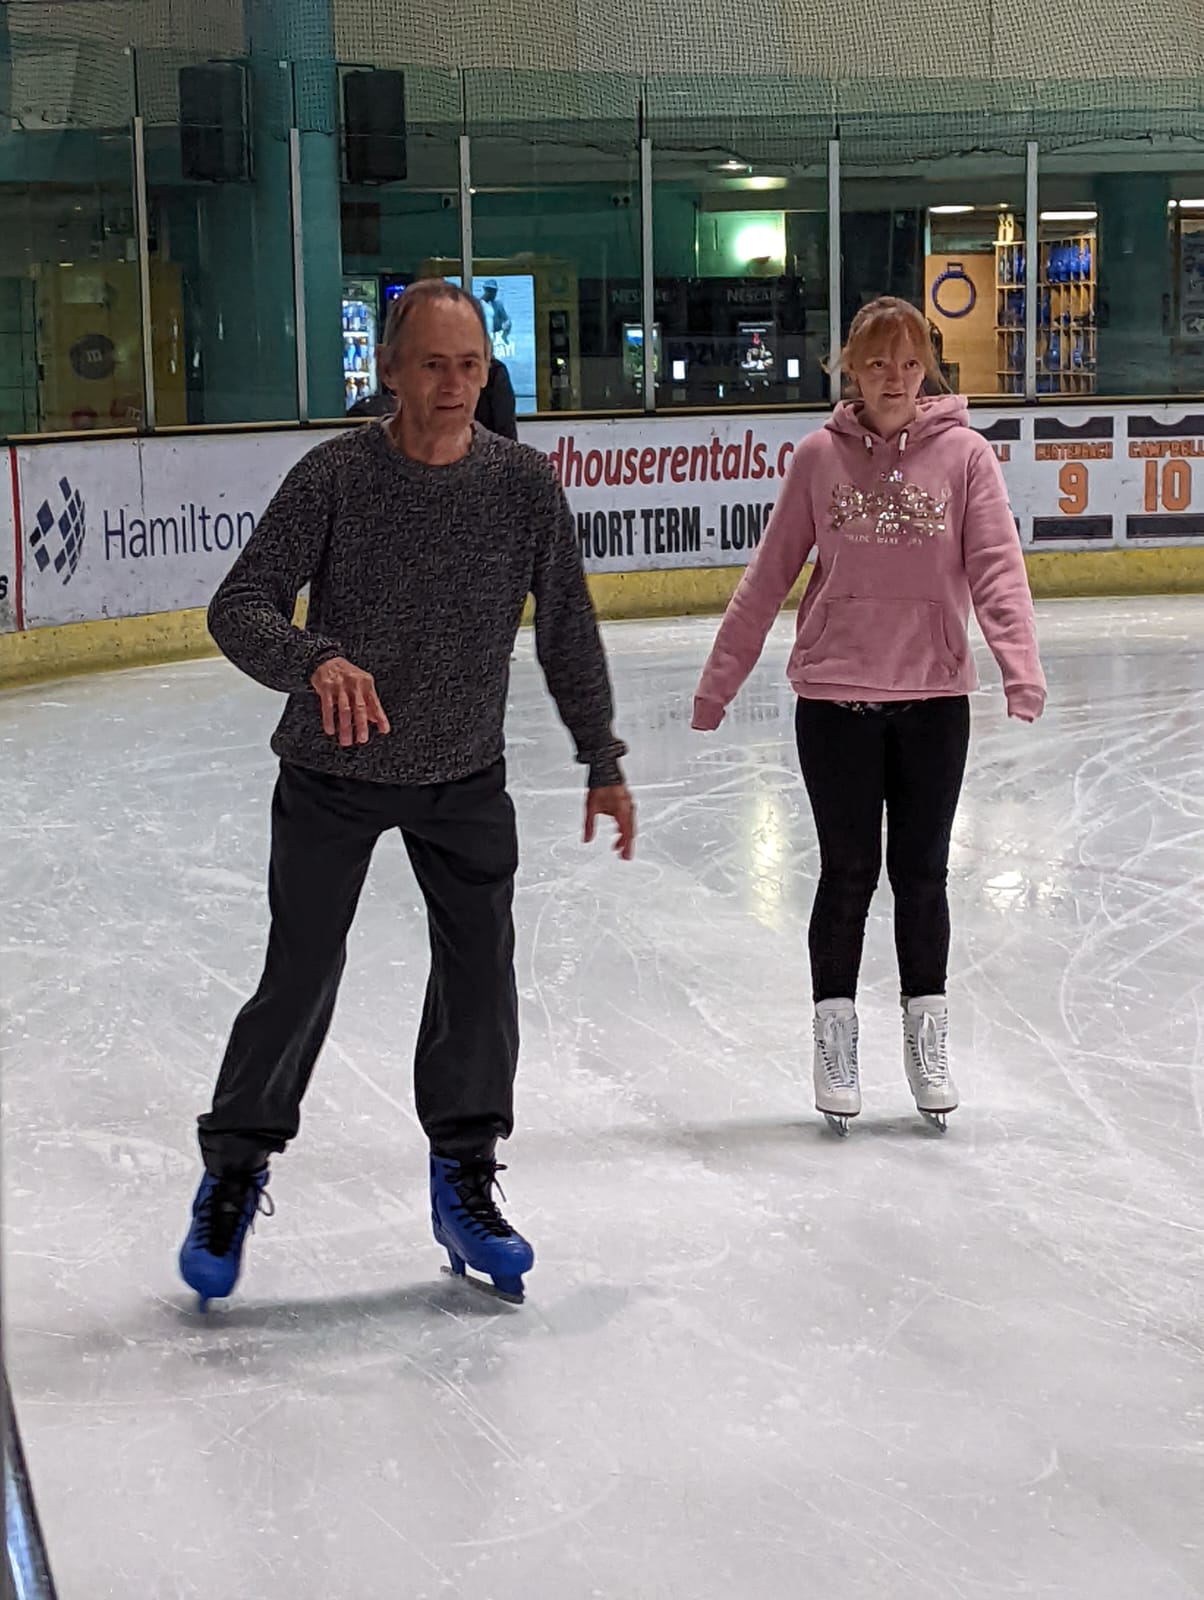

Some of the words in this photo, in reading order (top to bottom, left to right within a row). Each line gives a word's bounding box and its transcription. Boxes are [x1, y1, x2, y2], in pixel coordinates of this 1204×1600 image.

[1058, 462, 1089, 514] 9
[1144, 459, 1192, 512] 10
[104, 503, 255, 560] Hamilton
[641, 506, 701, 554] TERM
